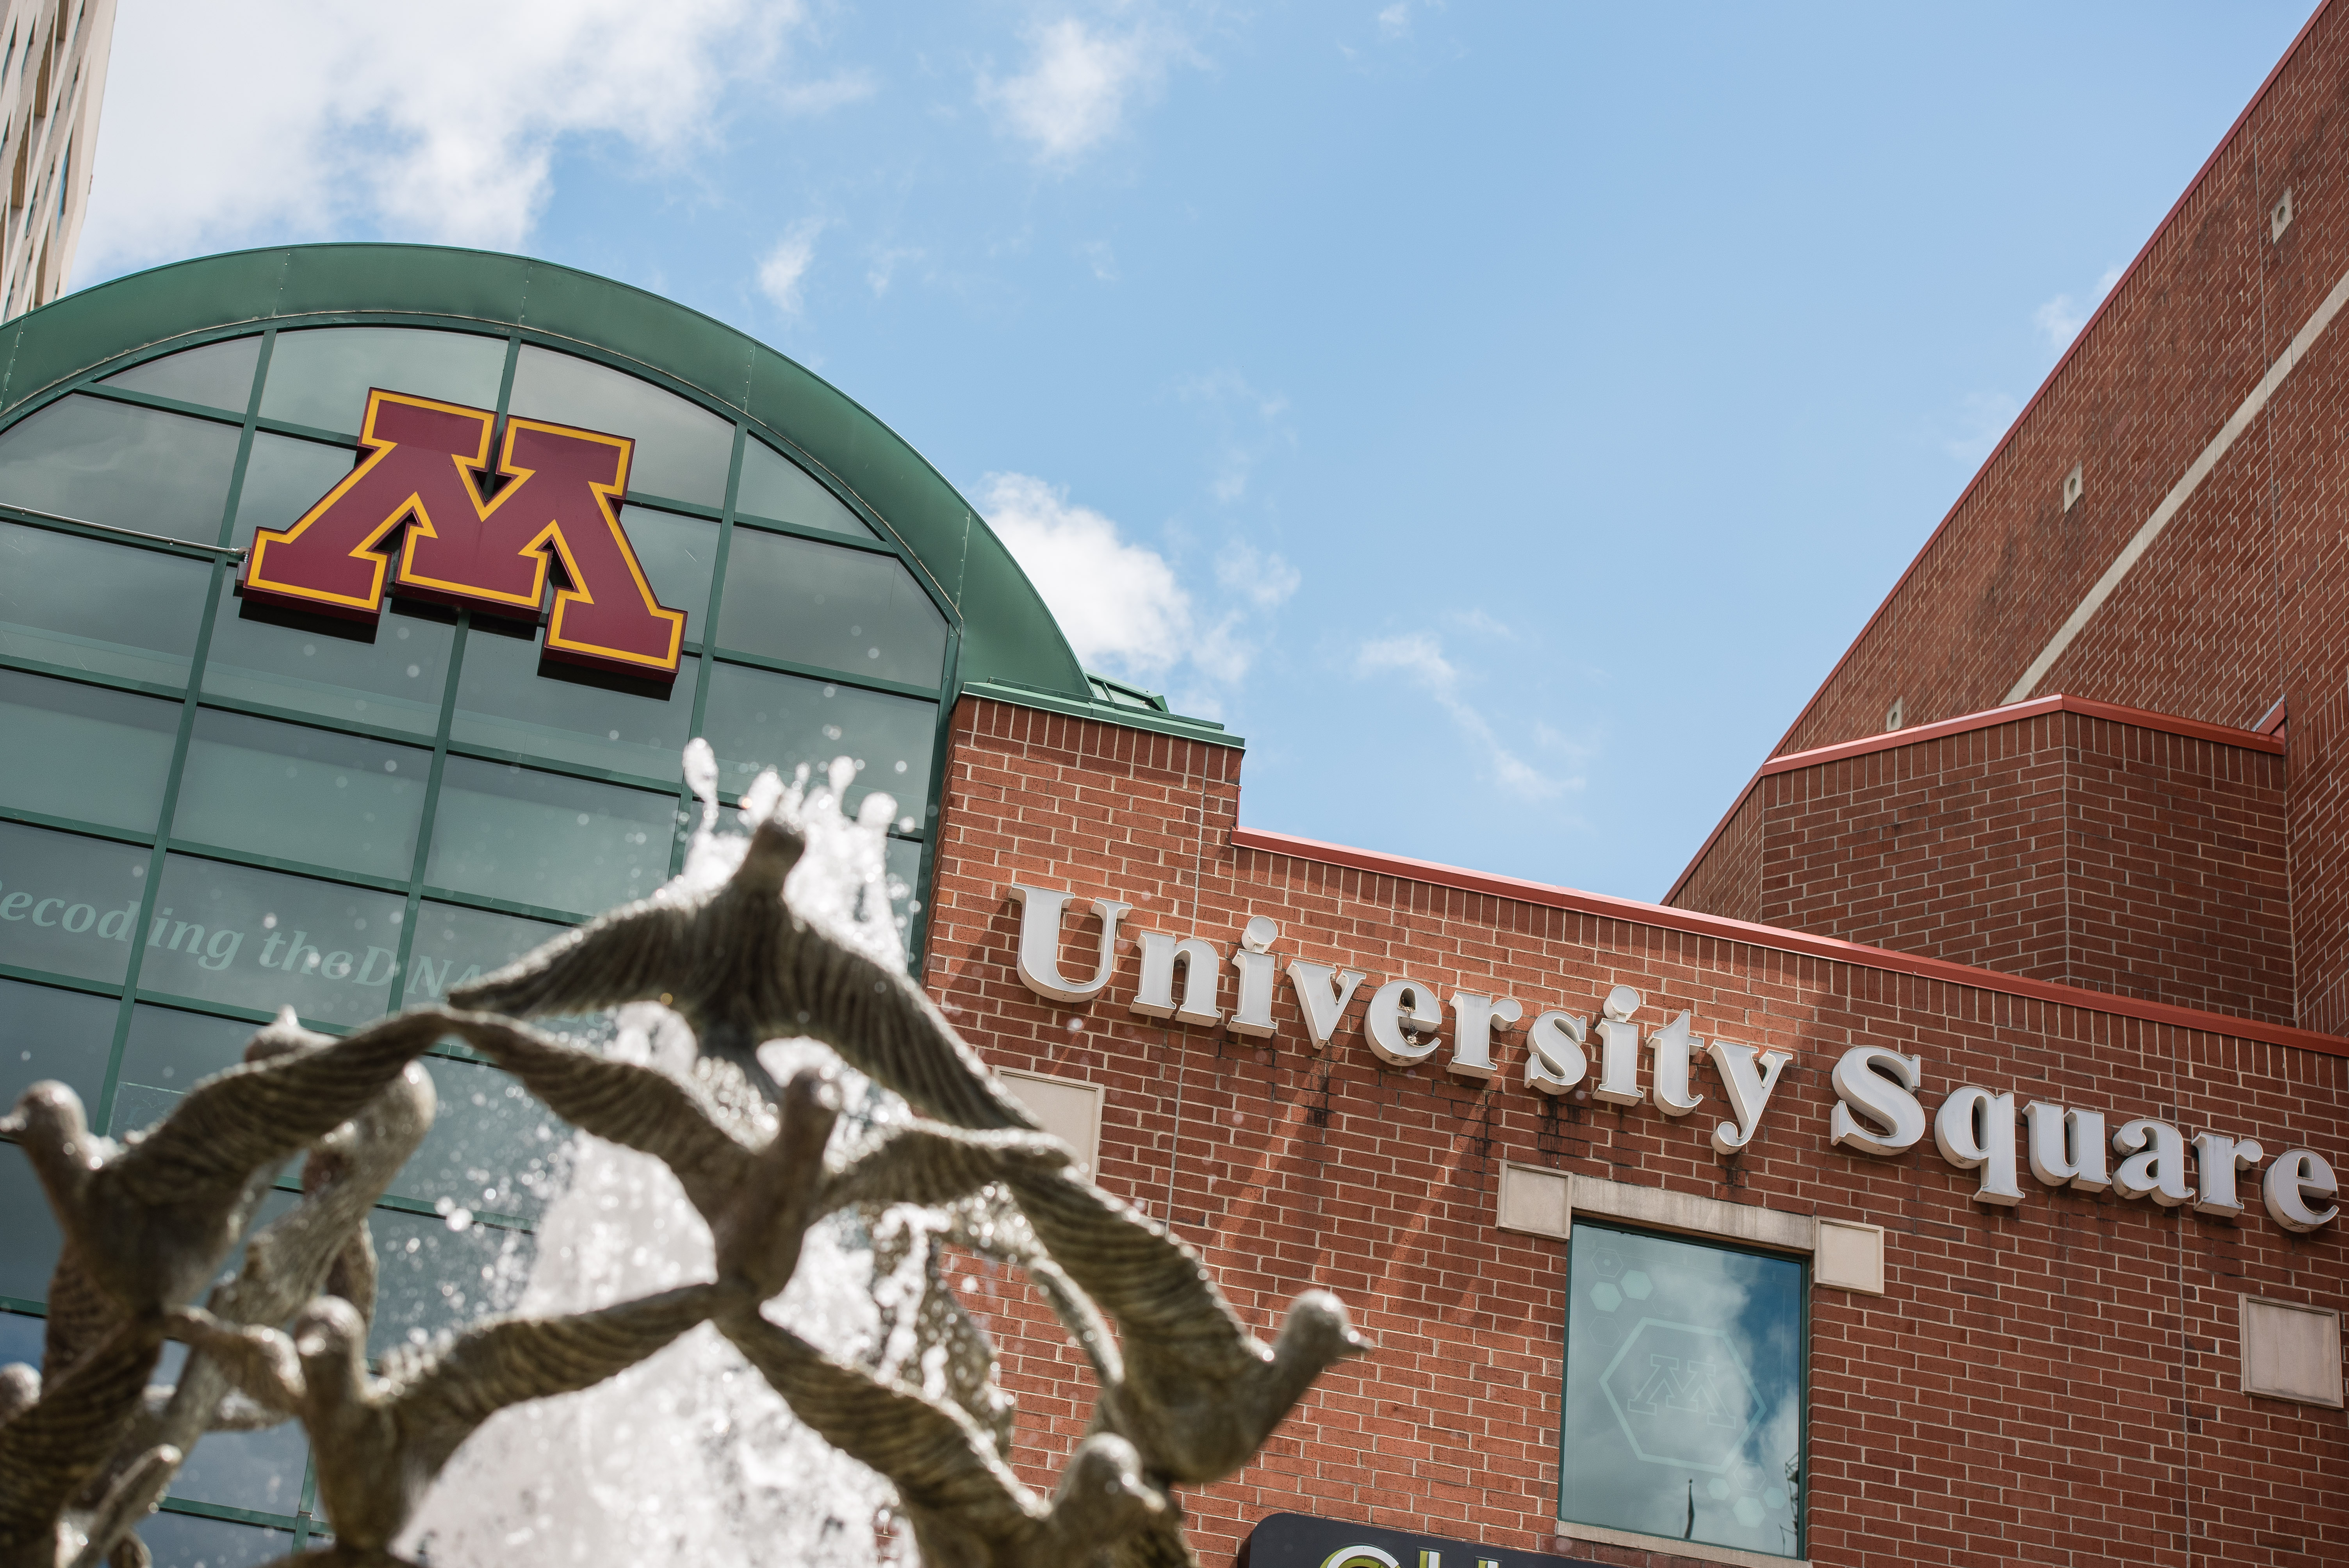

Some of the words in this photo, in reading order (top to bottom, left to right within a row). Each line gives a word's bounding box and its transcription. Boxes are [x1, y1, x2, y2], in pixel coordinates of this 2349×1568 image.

[244, 387, 688, 684] M
[0, 879, 245, 971] ecoding
[1010, 882, 1793, 1155] University
[1830, 1045, 2339, 1233] Square
